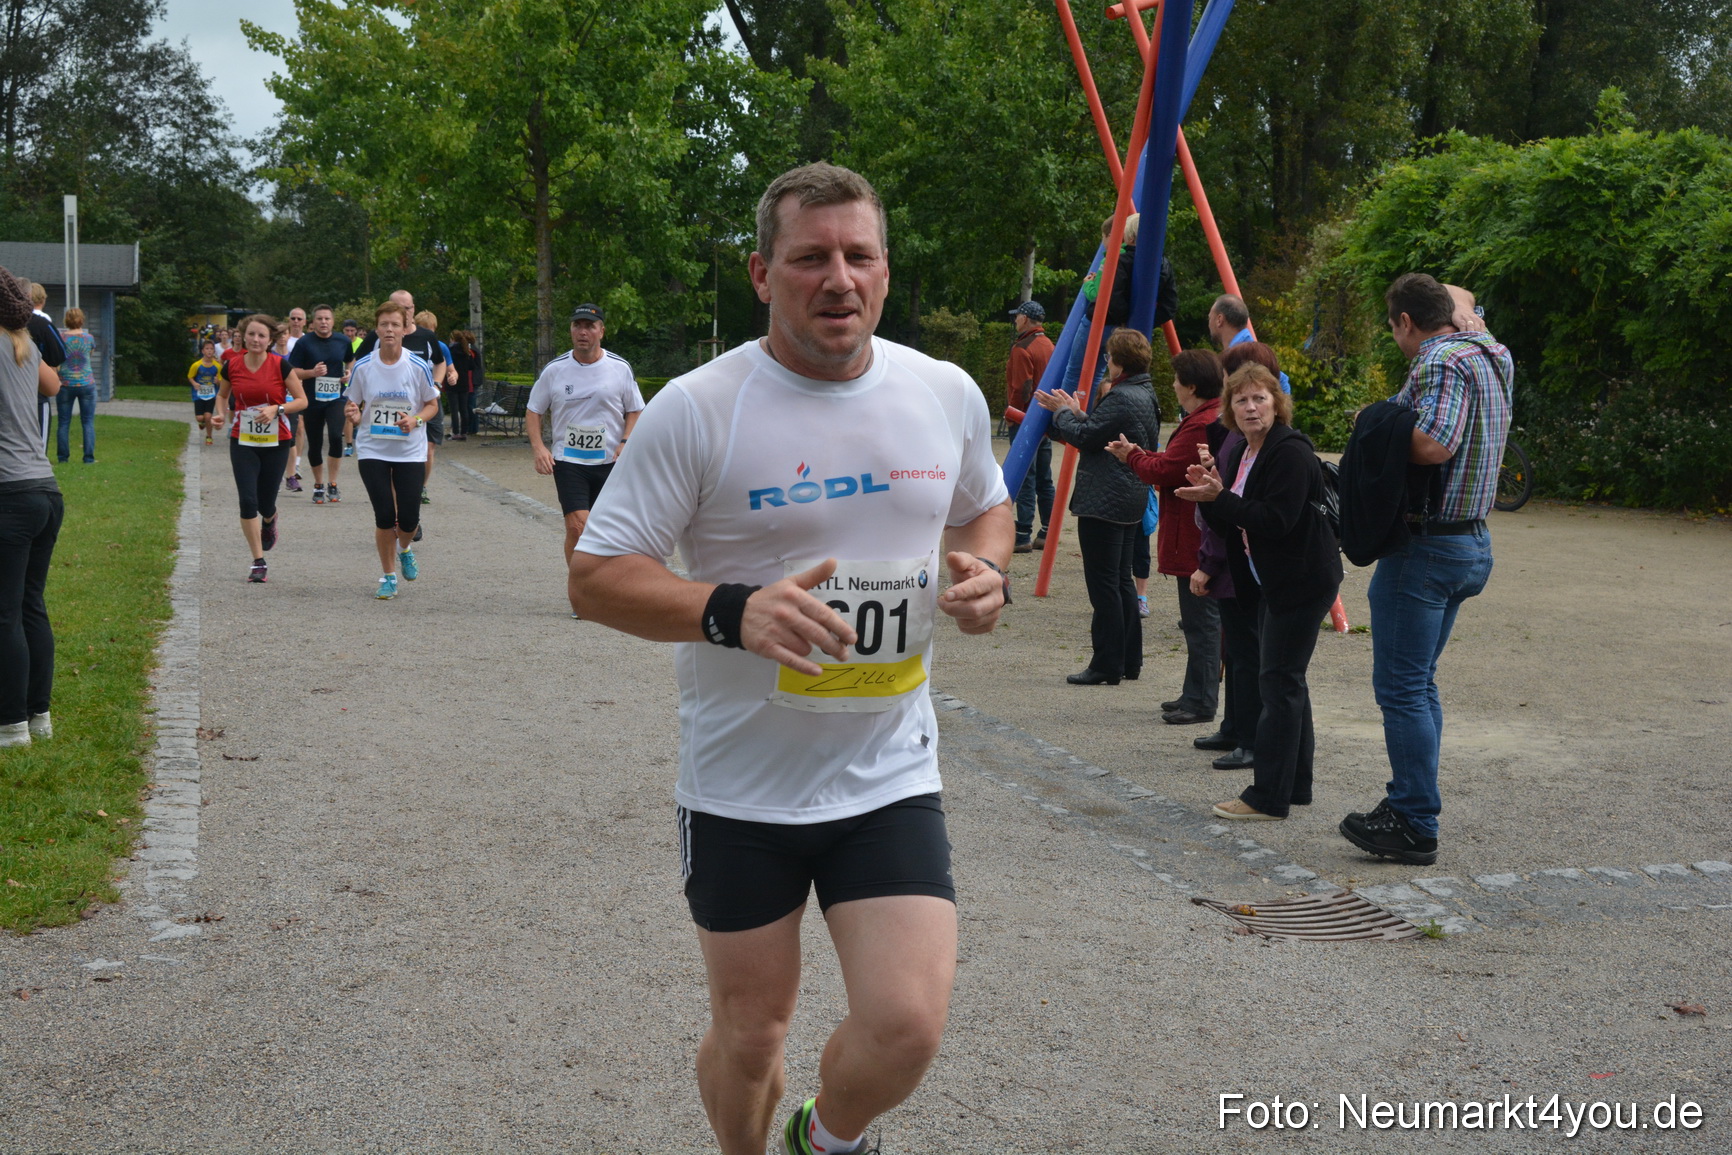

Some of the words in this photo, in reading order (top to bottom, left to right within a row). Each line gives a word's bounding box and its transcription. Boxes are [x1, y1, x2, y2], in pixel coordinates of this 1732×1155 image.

[317, 382, 340, 393] 2033
[247, 420, 271, 434] 182
[568, 432, 603, 449] 3422
[890, 464, 946, 480] energie
[848, 576, 915, 591] Neumarkt
